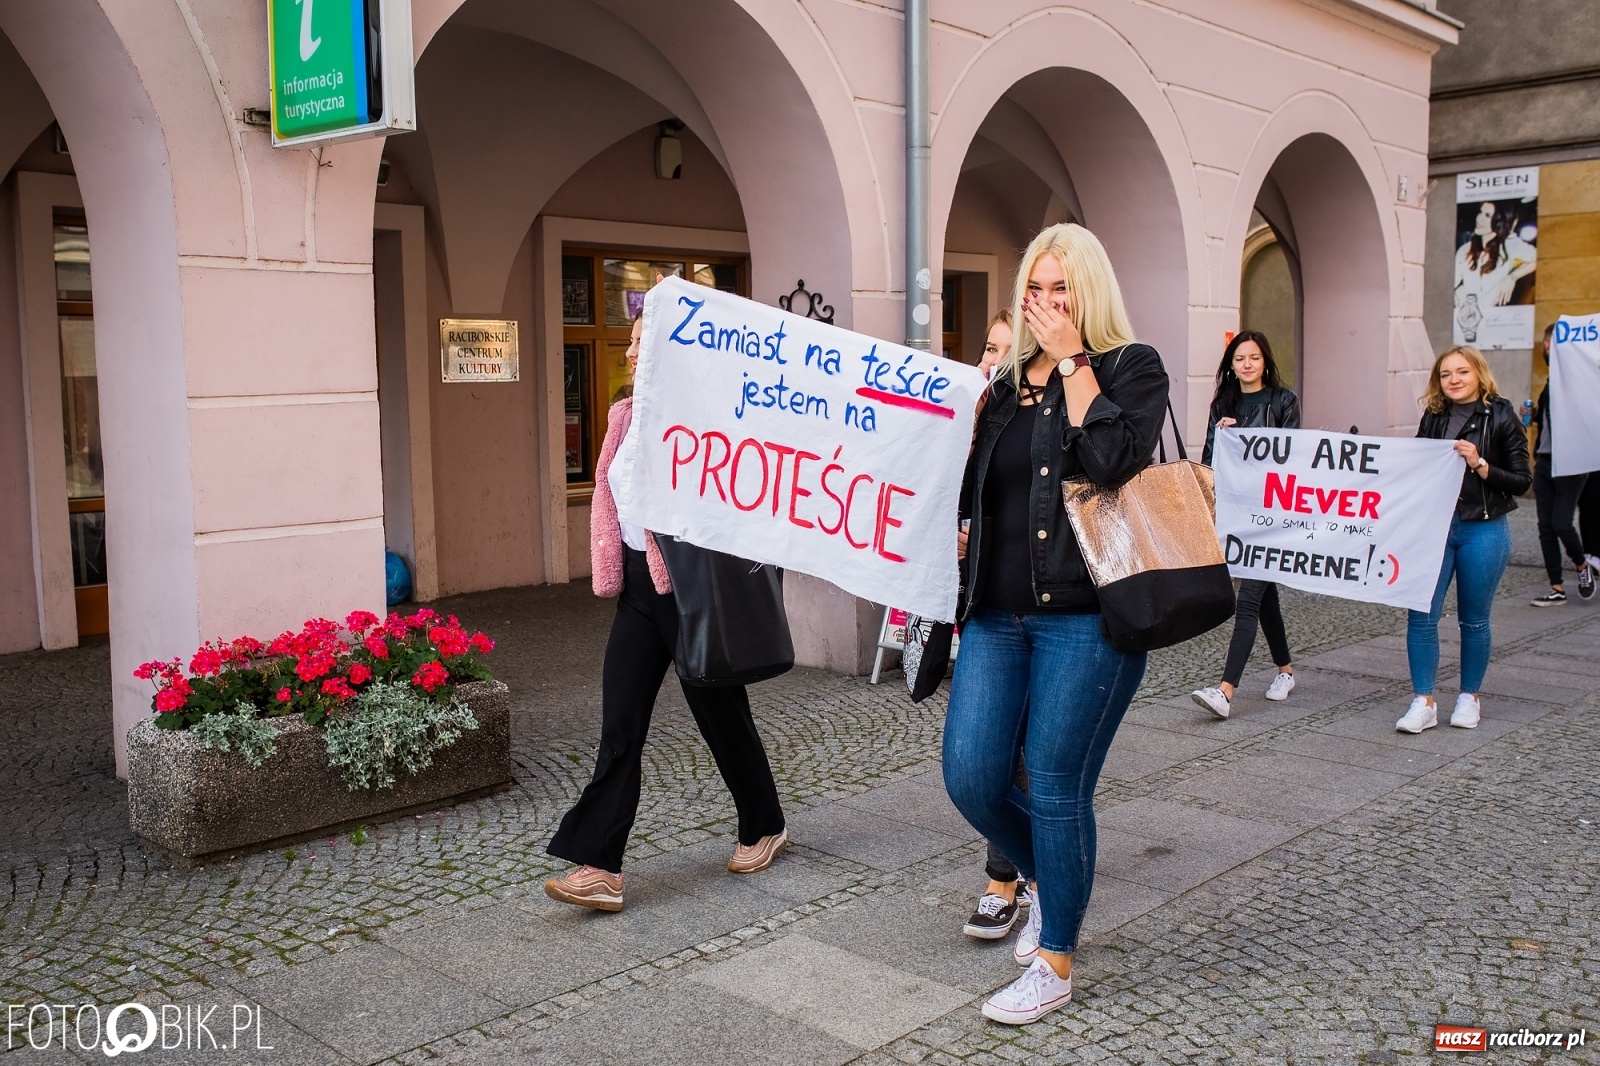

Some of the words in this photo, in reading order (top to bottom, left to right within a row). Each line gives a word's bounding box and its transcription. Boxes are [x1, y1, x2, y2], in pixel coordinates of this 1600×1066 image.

[283, 69, 344, 95] informacja
[284, 95, 345, 120] turystyczna
[1465, 174, 1529, 189] SHEEN
[449, 331, 510, 343] RACIBORSKIE
[457, 347, 503, 358] CENTRUM
[669, 296, 788, 366] Zamiast
[804, 342, 840, 375] na
[861, 343, 951, 404] teście
[458, 363, 502, 374] KULTURY
[735, 371, 829, 420] jestem
[845, 400, 877, 433] na
[1239, 434, 1292, 464] YOU
[1311, 438, 1381, 474] ARE
[662, 424, 916, 563] PROTEŚCIE
[1263, 472, 1382, 520] NEVER
[1250, 513, 1274, 526] TOO
[1282, 518, 1318, 531] SMALL
[1326, 521, 1338, 532] TO
[1343, 524, 1374, 537] MAKE
[1306, 532, 1314, 541] A
